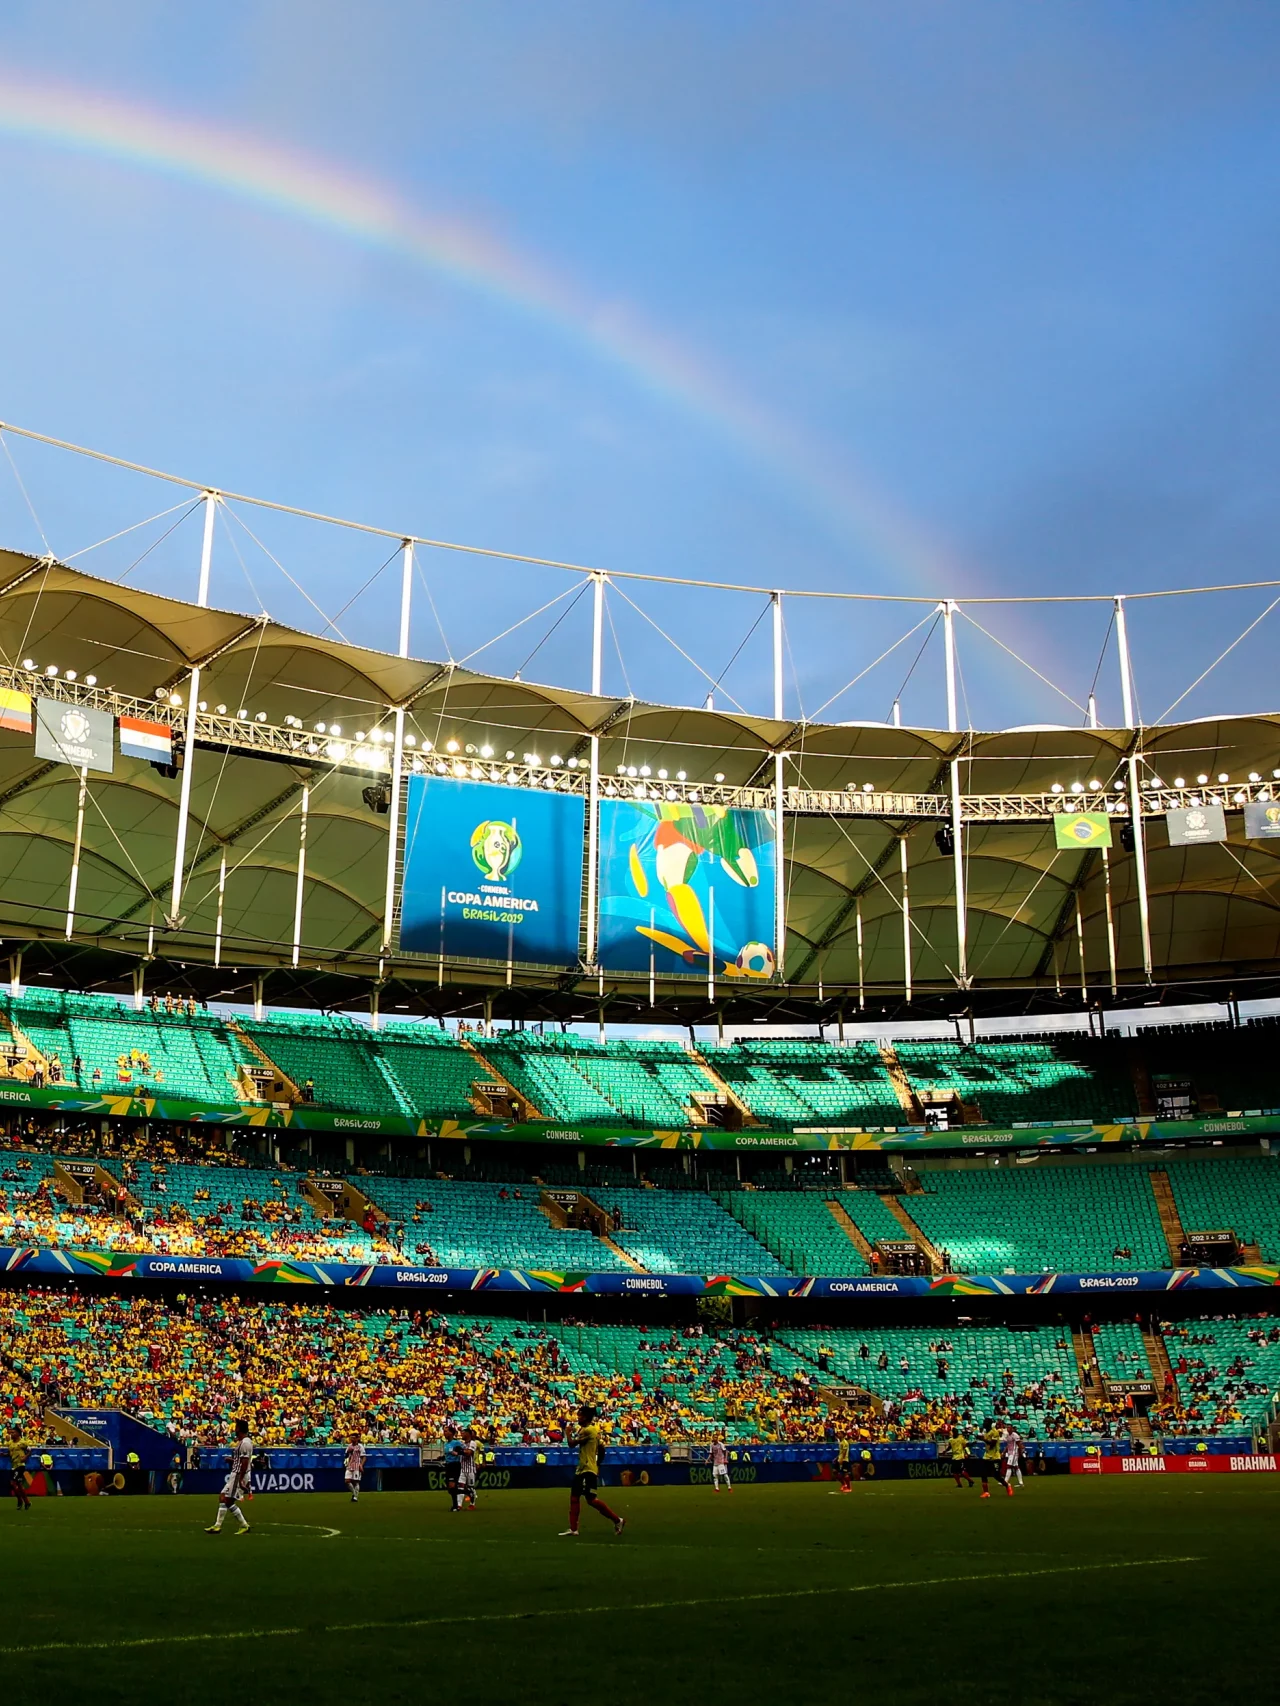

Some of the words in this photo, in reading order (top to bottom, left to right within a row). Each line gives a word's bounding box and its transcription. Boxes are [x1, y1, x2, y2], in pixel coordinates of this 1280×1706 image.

[447, 891, 482, 906] COPA
[483, 895, 539, 912] AMERICA
[499, 910, 524, 924] 2019
[363, 1120, 381, 1130] 2019
[735, 1137, 758, 1146] COPA
[760, 1137, 798, 1146] AMERICA
[993, 1134, 1013, 1142] 2019
[149, 1261, 178, 1273] COPA
[178, 1262, 222, 1275] AMERICA
[428, 1273, 448, 1284] 2019
[1116, 1277, 1139, 1287] 2019
[829, 1282, 854, 1292] COPA
[855, 1283, 899, 1292] AMERICA
[1122, 1457, 1166, 1472] BRAHMA
[1230, 1456, 1276, 1471] BRAHMA
[479, 1469, 511, 1487] 2019
[730, 1466, 757, 1482] 2019
